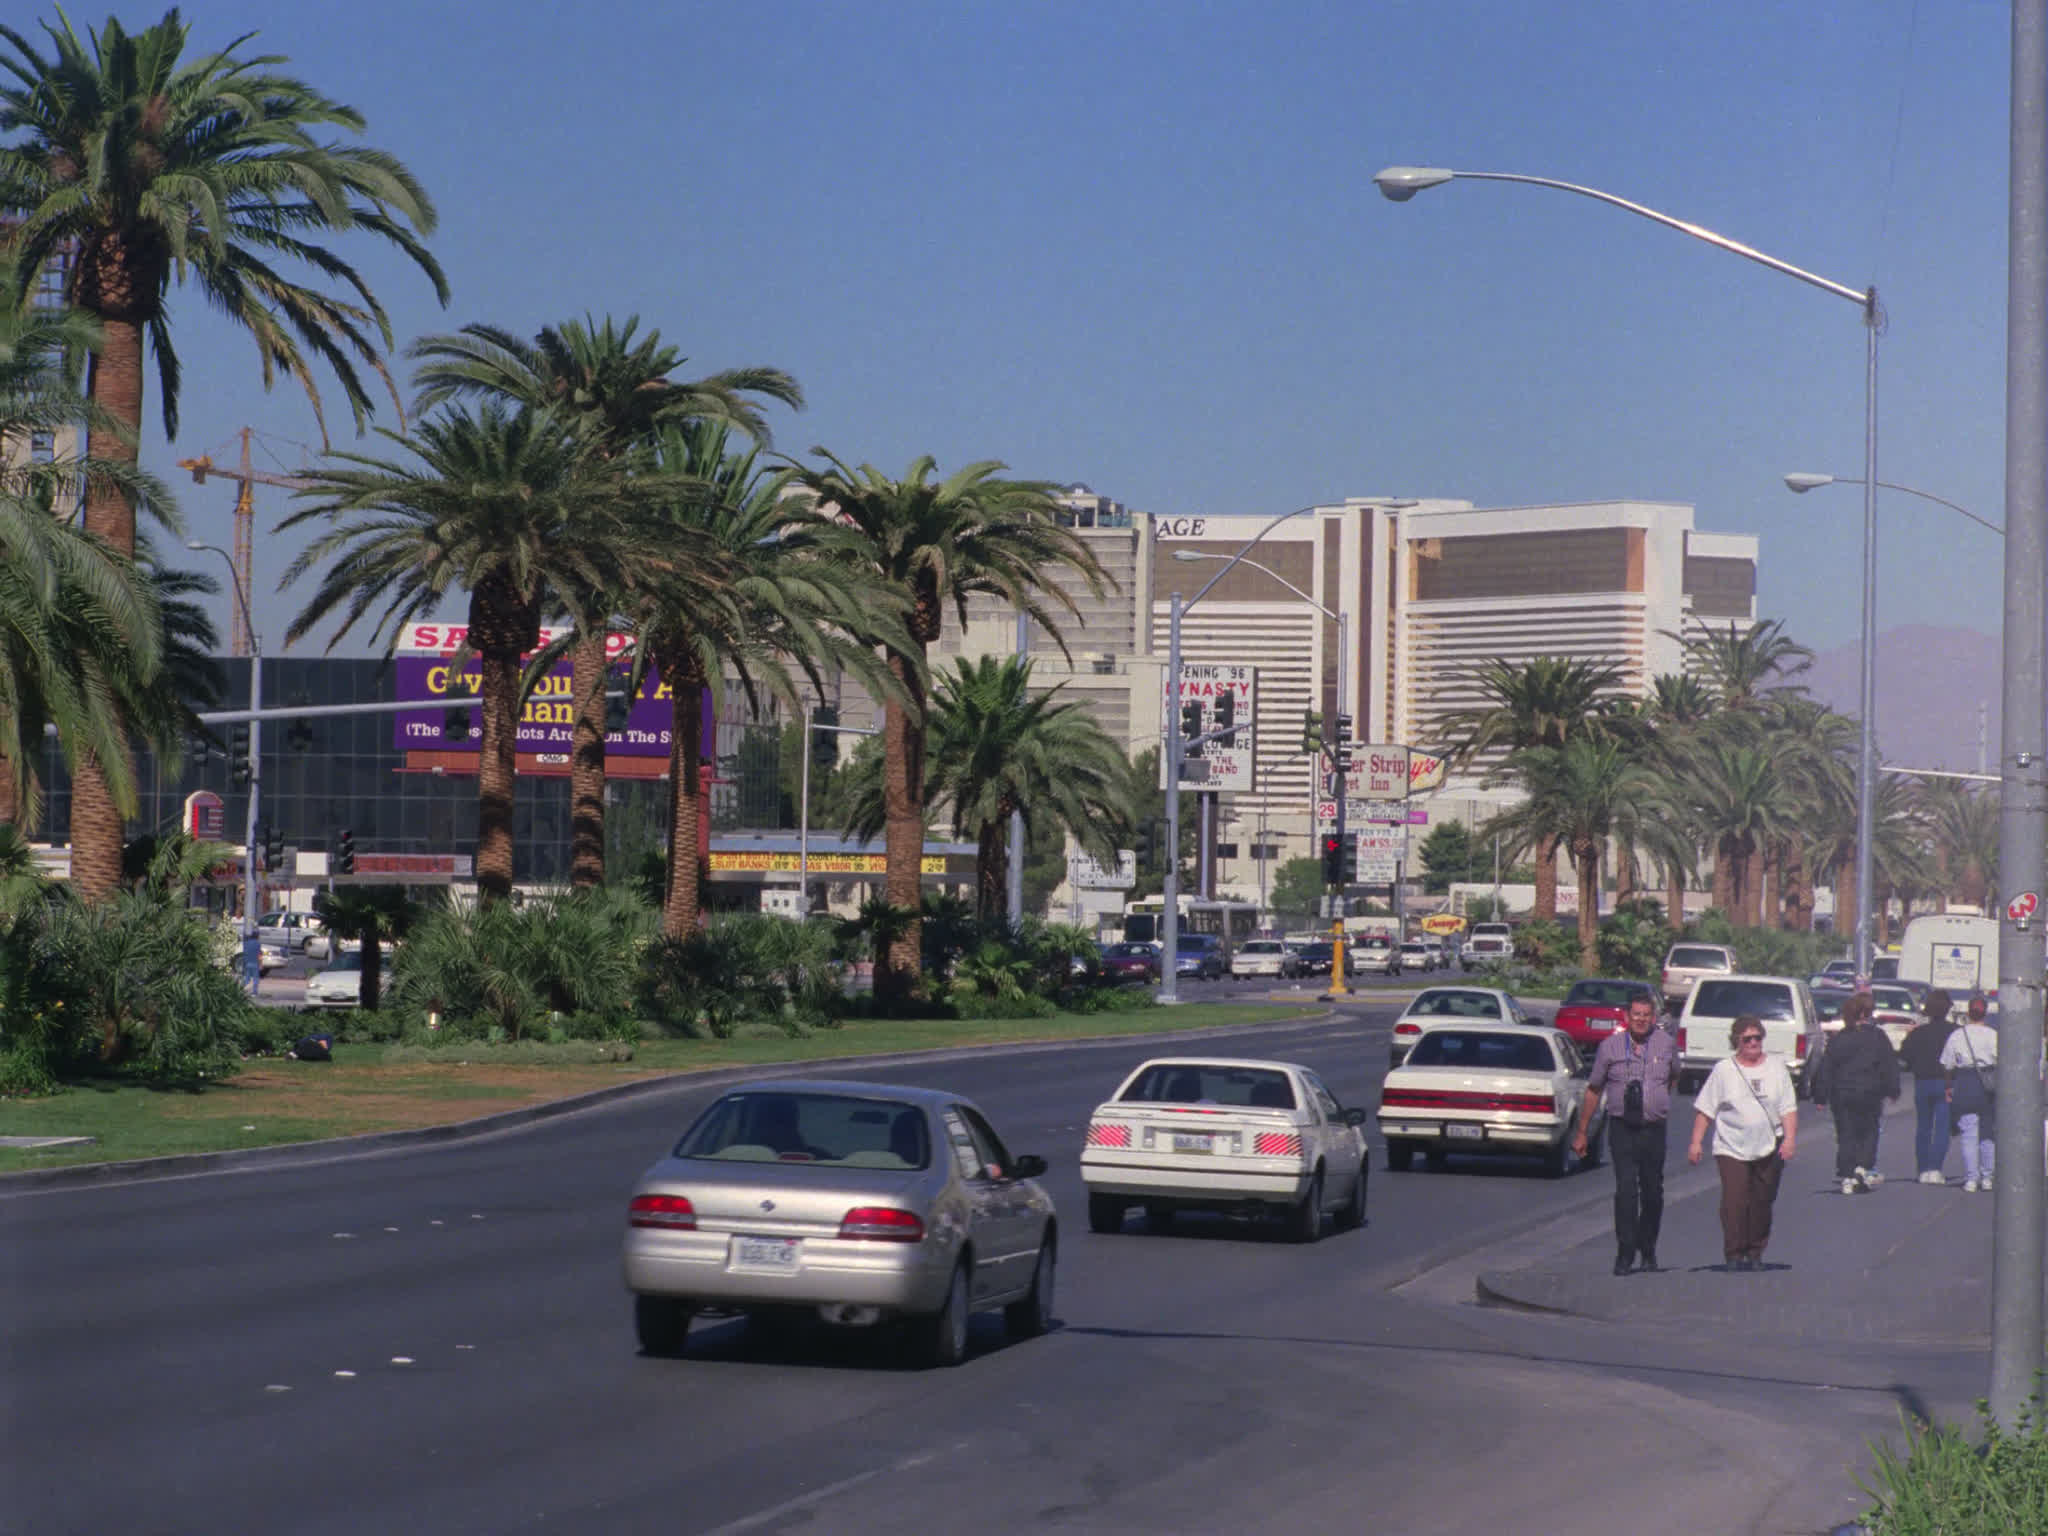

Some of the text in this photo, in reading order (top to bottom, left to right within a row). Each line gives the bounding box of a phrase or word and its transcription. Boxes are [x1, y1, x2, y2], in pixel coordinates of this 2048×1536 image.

[1156, 518, 1205, 537] AGE
[1178, 666, 1219, 679] PENING
[406, 724, 440, 736] (The
[516, 727, 545, 740] lots
[627, 731, 657, 743] The
[1370, 755, 1406, 779] Strip
[1370, 776, 1390, 791] Inn
